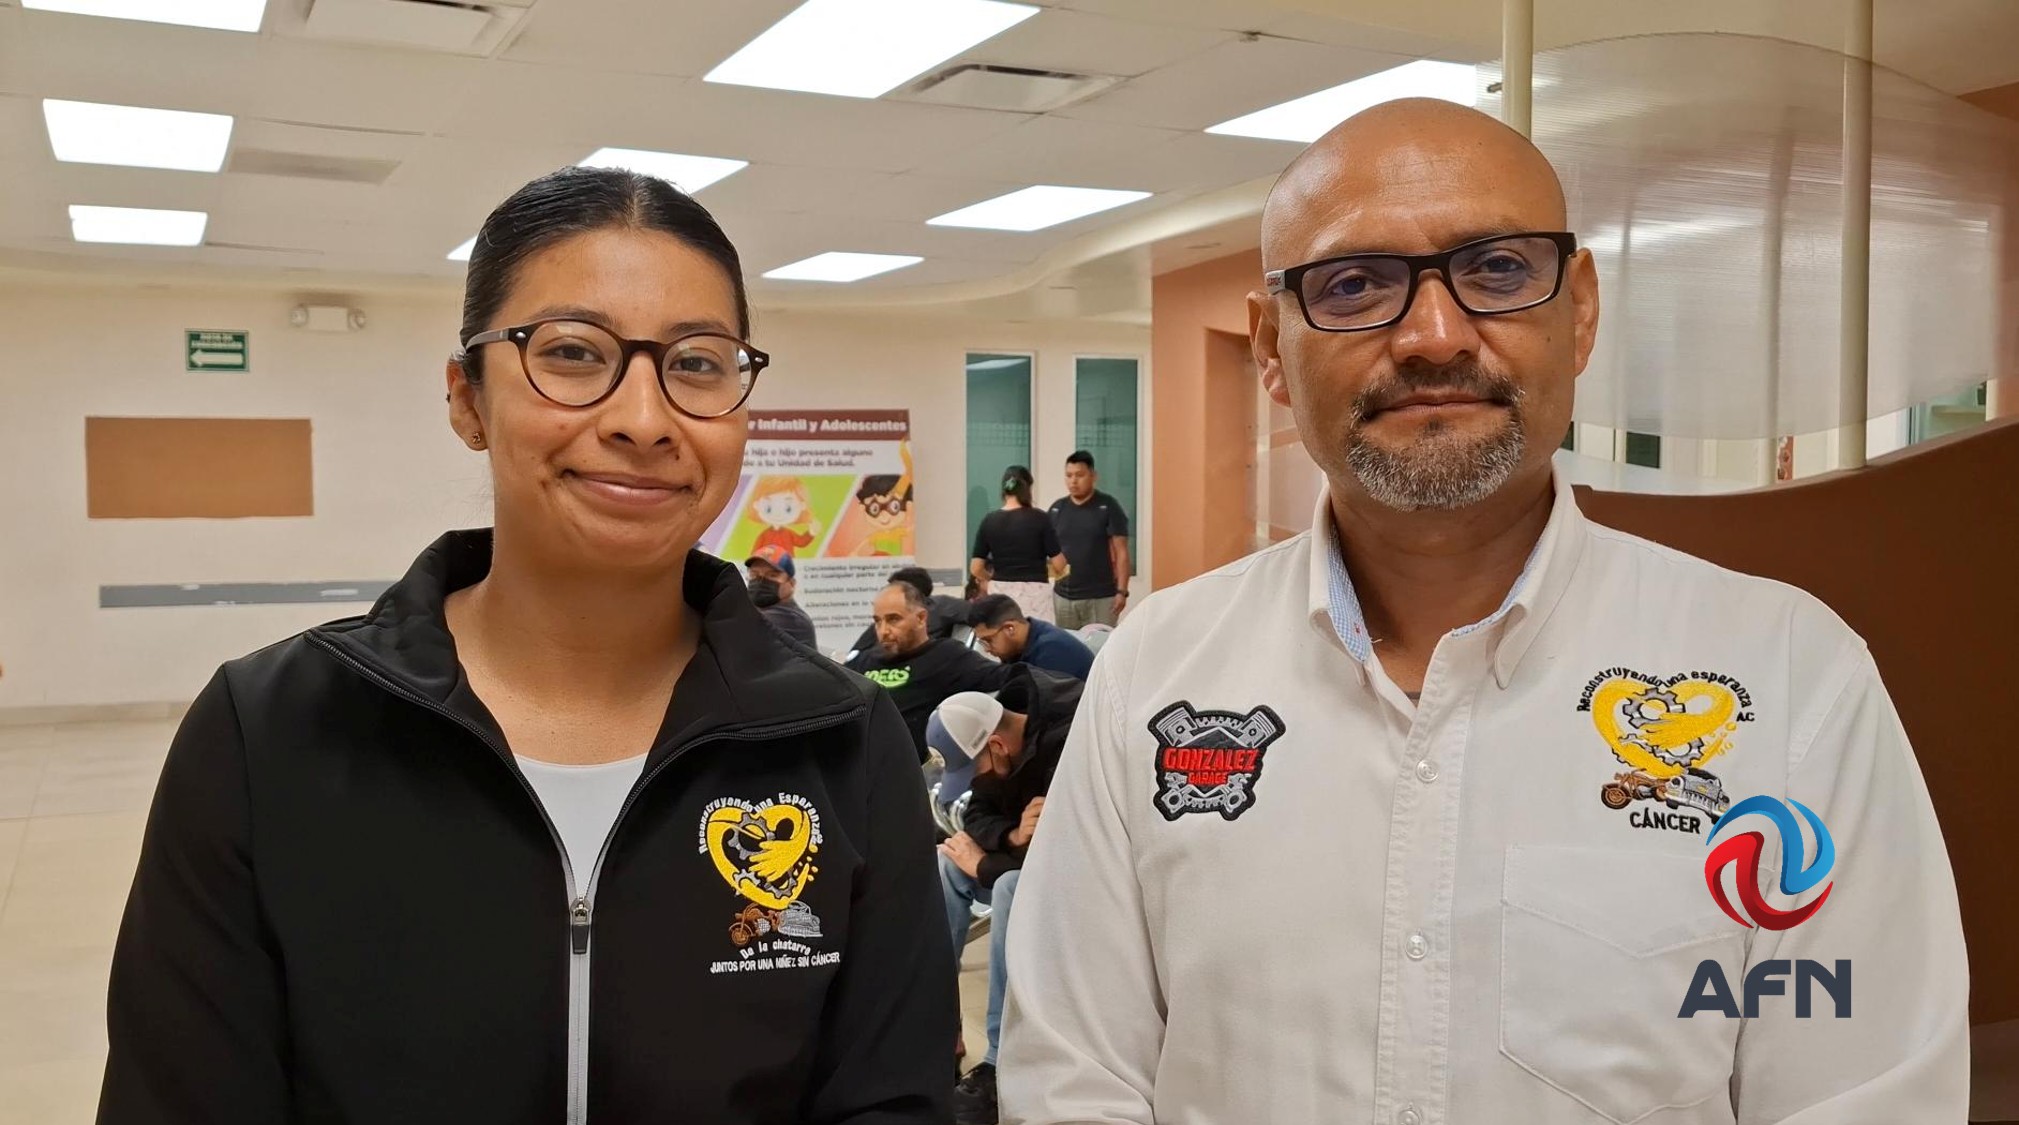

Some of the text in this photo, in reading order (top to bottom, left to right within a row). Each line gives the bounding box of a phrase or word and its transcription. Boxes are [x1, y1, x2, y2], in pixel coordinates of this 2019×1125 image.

[758, 419, 807, 430] Infantil
[809, 421, 818, 433] y
[820, 419, 907, 431] Adolescentes
[1662, 672, 1688, 688] una
[1690, 670, 1753, 708] esperanza
[1164, 748, 1259, 771] GONZALEZ
[1187, 771, 1228, 785] GARAGE
[753, 797, 774, 812] una
[710, 961, 738, 974] JUNTOS
[740, 960, 756, 972] POR
[758, 958, 774, 970] UNA
[798, 956, 810, 967] SIN
